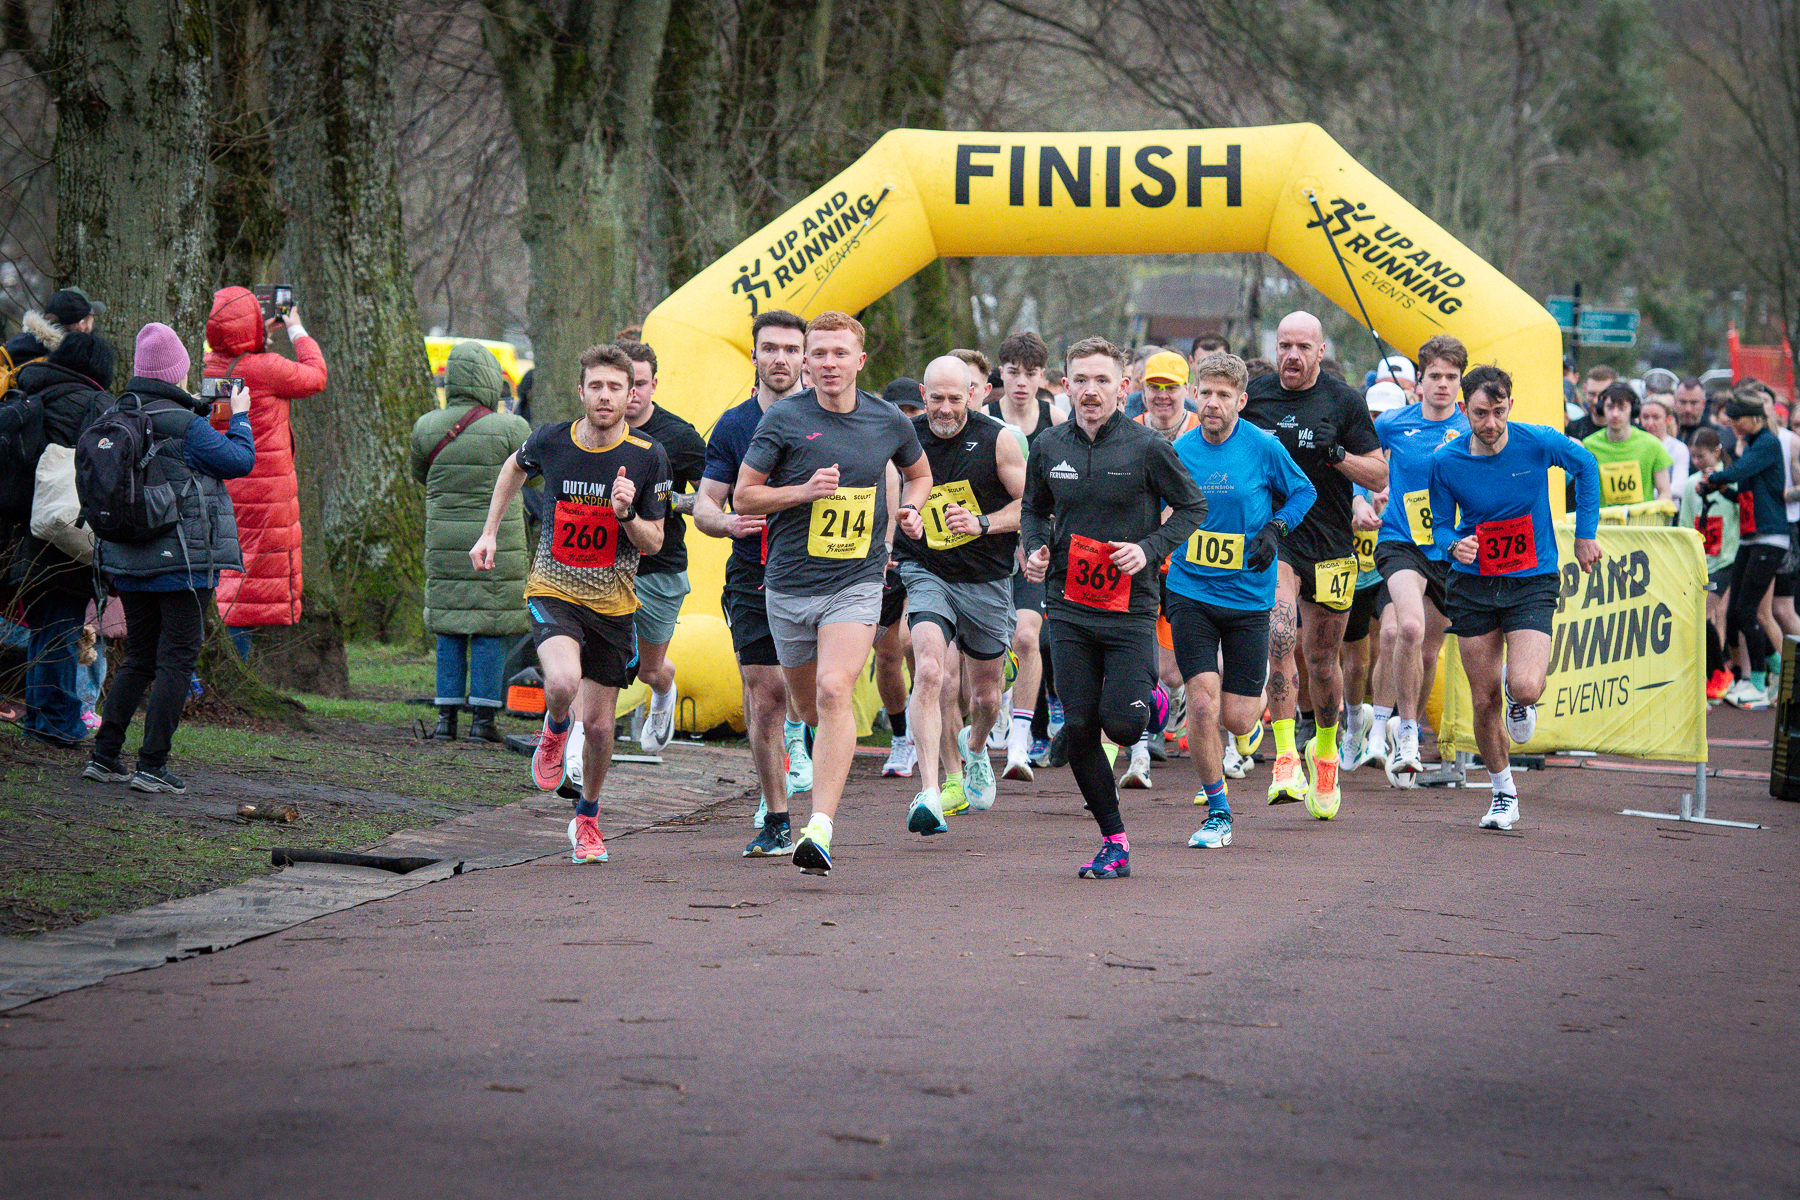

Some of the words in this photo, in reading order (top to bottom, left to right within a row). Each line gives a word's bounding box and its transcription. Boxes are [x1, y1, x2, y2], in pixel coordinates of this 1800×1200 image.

[955, 144, 1242, 208] FINISH
[768, 230, 799, 261] UP
[802, 191, 848, 237] AND
[773, 194, 875, 289] RUNNING
[814, 239, 861, 281] EVENTS
[1344, 233, 1463, 315] RUNNING
[1374, 223, 1414, 249] UP
[1405, 249, 1466, 288] AND
[1362, 271, 1416, 309] EVENTS
[562, 479, 606, 497] OUTLAW
[1610, 475, 1636, 493] 166
[561, 523, 608, 550] 260
[820, 508, 866, 538] 214
[1196, 534, 1235, 565] 105
[1486, 533, 1527, 560] 378
[1075, 558, 1121, 591] 369
[1330, 571, 1350, 599] 47
[1557, 561, 1580, 614] P
[1582, 550, 1651, 610] AND
[1546, 602, 1673, 676] UNNING
[1555, 675, 1630, 718] EVENTS
